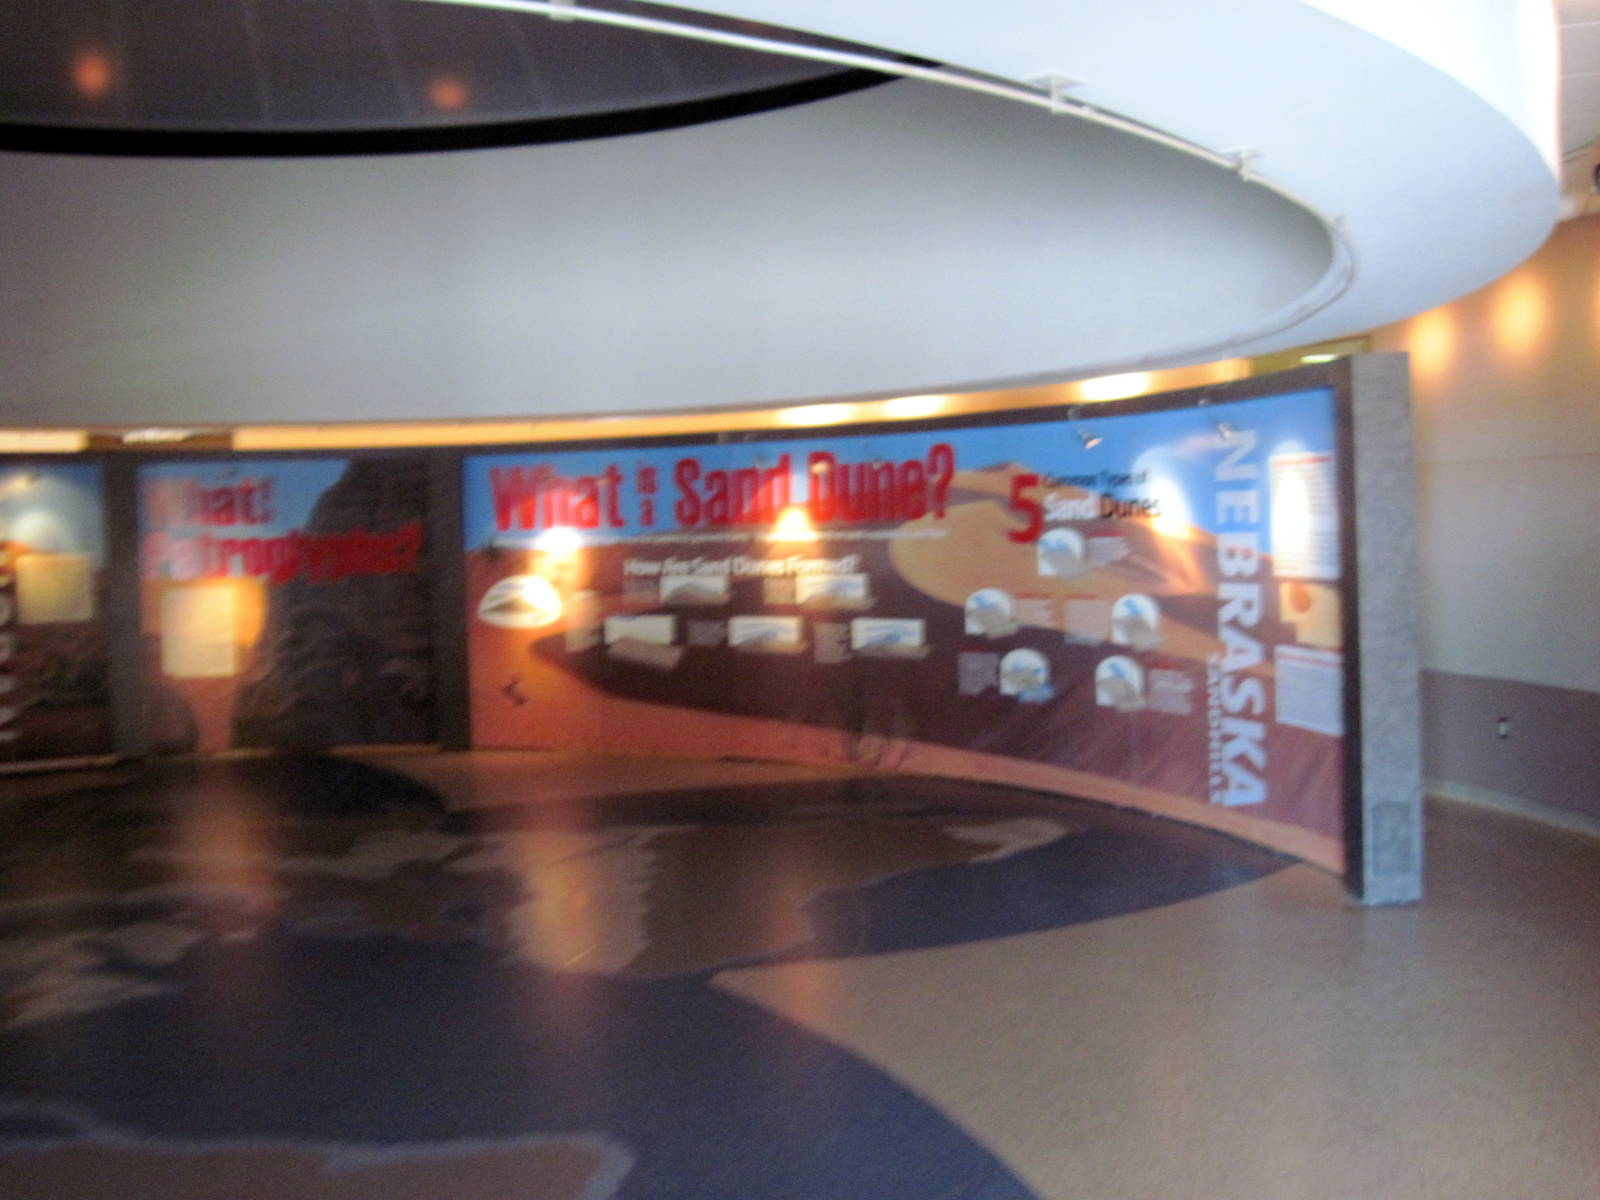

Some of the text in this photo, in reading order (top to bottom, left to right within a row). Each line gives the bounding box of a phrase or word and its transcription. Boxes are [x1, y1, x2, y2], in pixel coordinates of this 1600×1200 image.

[490, 464, 625, 531] What
[674, 456, 790, 527] Sand
[808, 443, 954, 523] Dune?
[1008, 474, 1044, 544] 5
[1045, 492, 1161, 521] Sand Dunes
[1215, 430, 1268, 807] NEBRASKA
